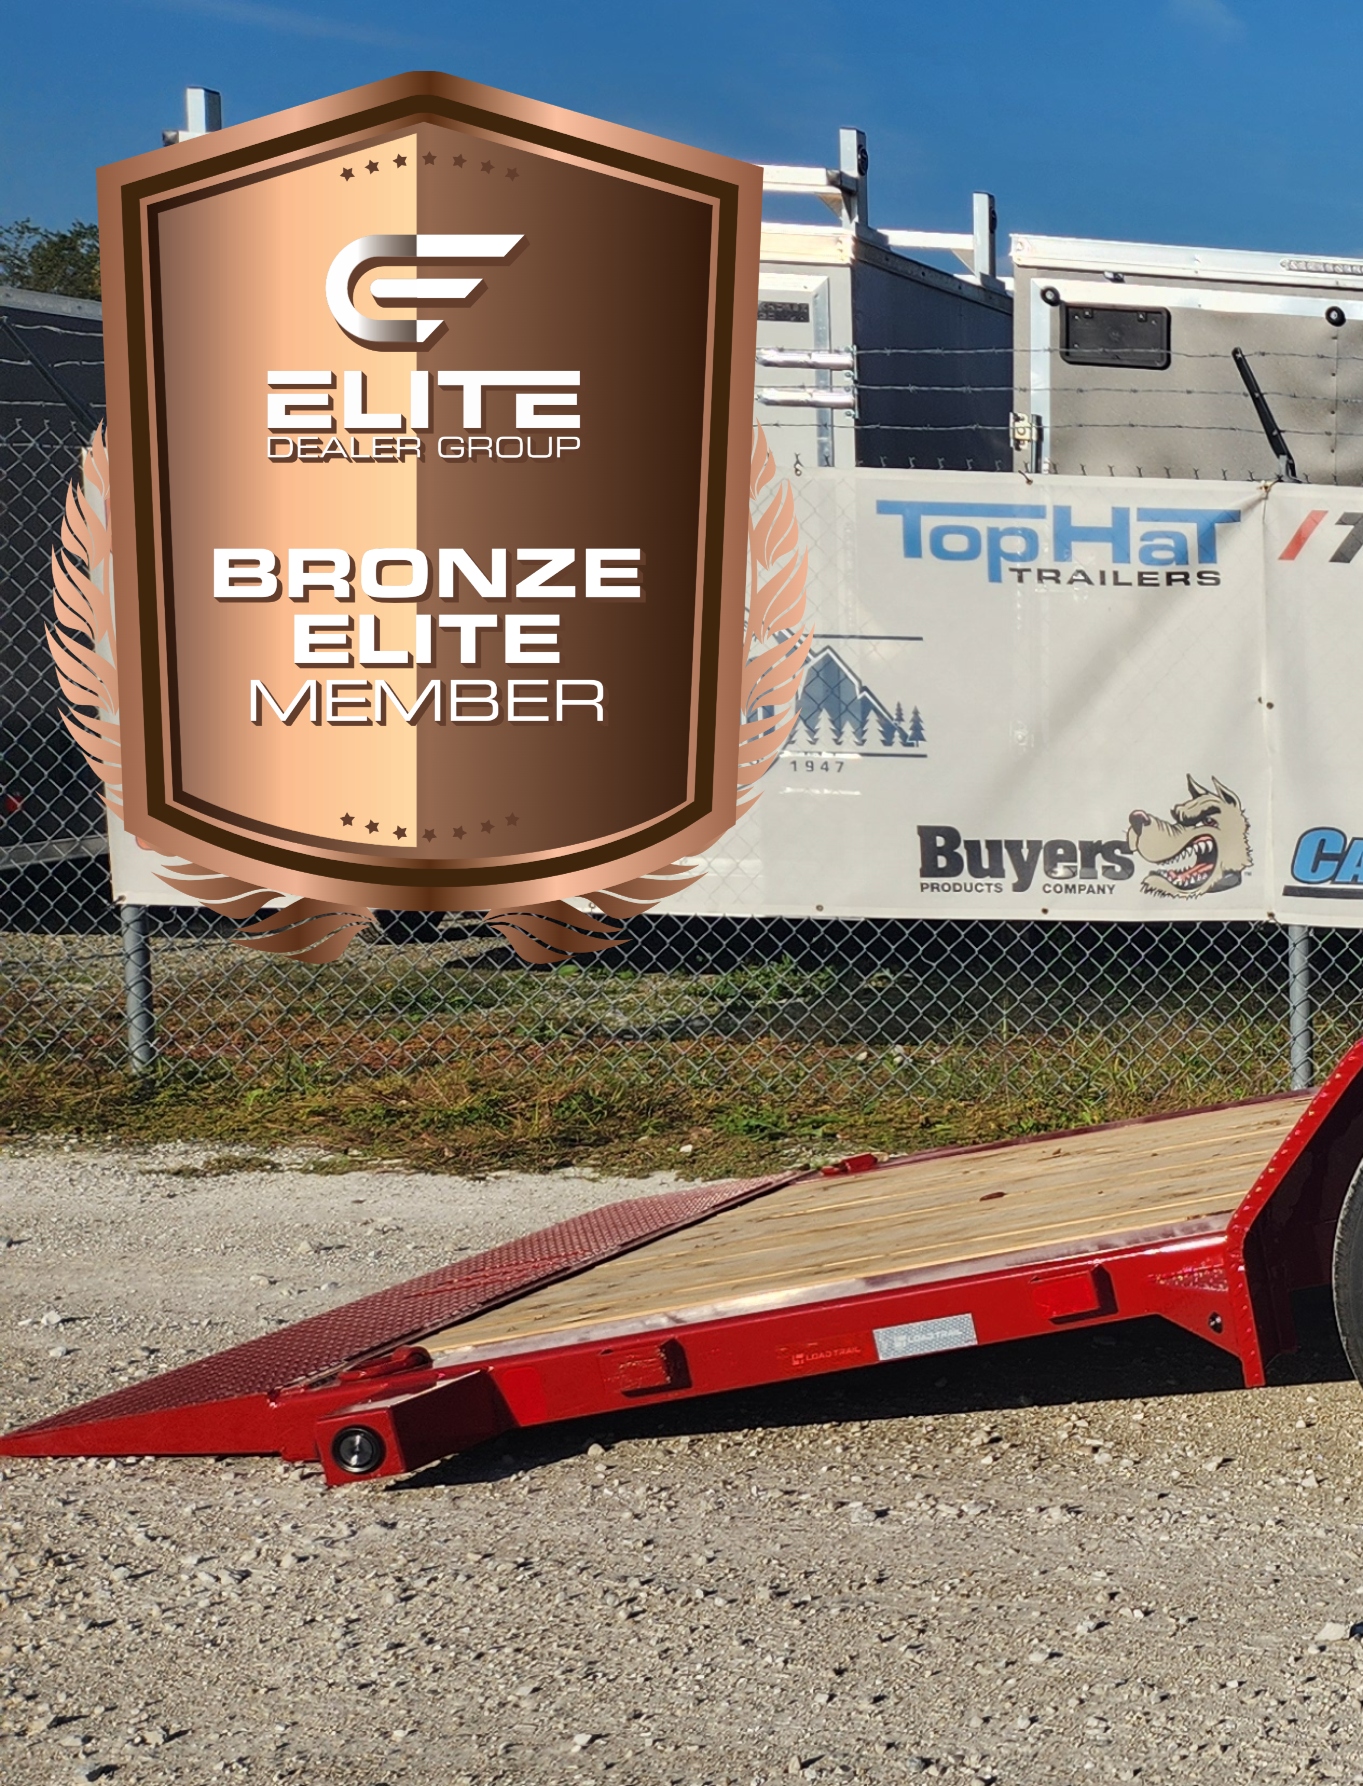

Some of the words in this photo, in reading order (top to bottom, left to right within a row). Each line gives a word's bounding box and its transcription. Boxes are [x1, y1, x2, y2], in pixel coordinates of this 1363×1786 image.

[1008, 567, 1222, 587] TRAILERS
[789, 760, 846, 774] 1947
[917, 825, 1135, 893] Buyers
[919, 881, 1004, 894] PRODUCTS
[1041, 883, 1116, 896] COMPANY
